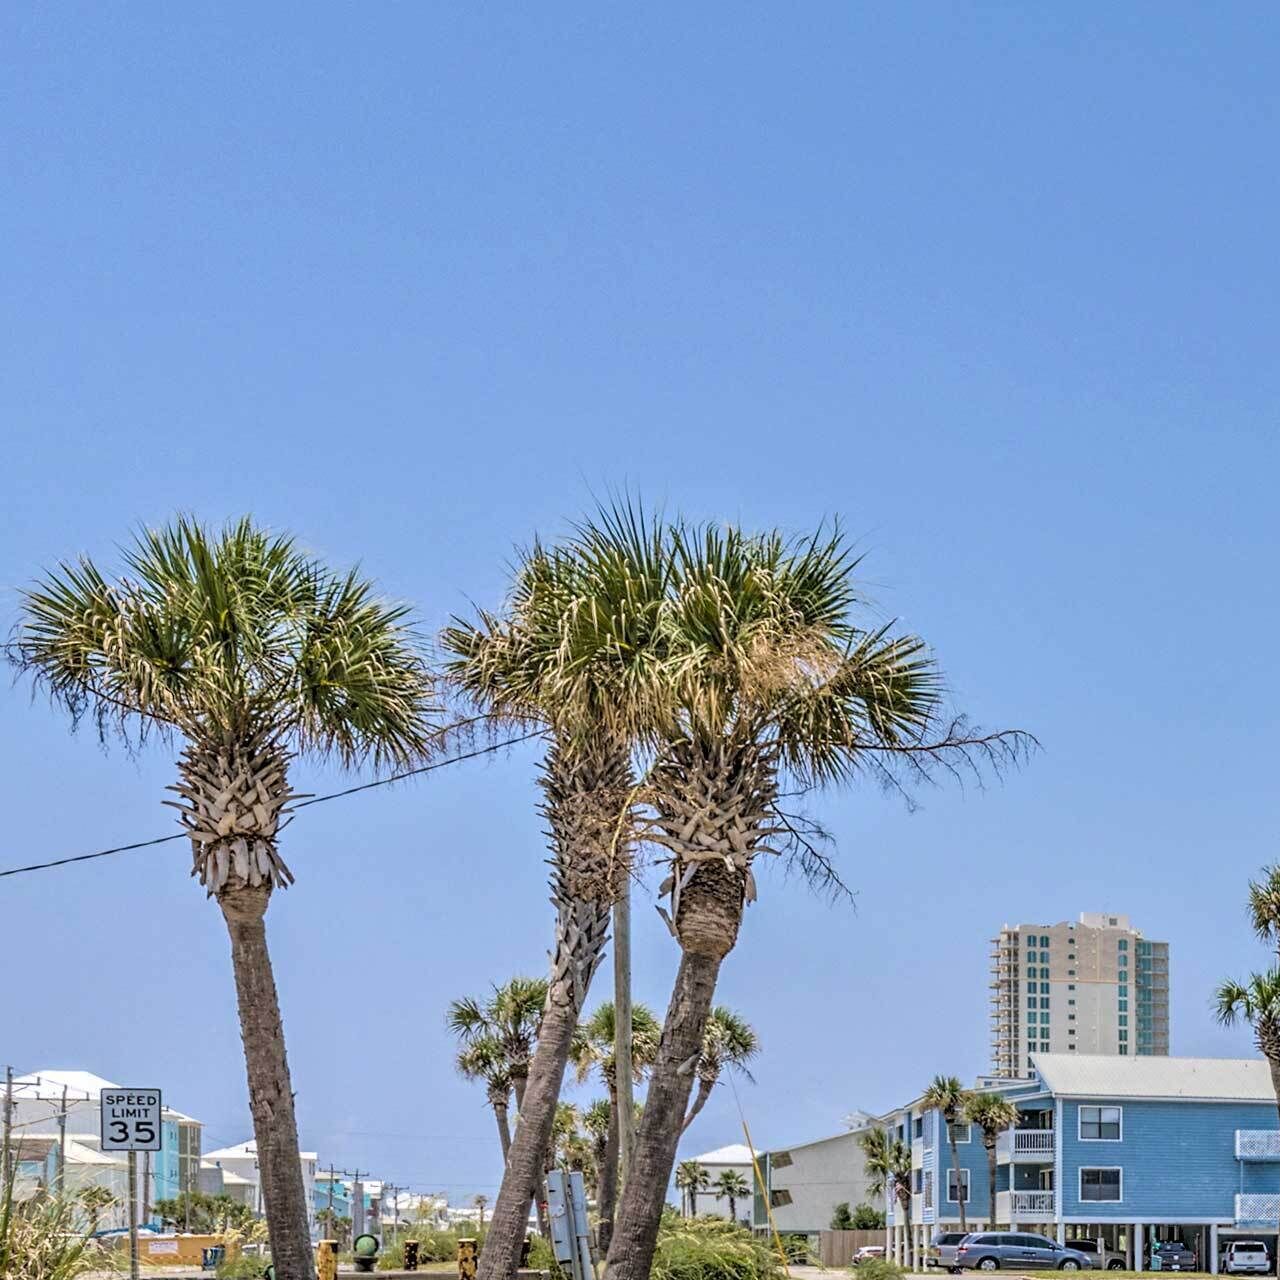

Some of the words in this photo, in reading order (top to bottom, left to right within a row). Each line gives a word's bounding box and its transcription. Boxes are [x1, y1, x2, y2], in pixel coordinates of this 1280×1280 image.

[106, 1095, 157, 1106] SPEED
[112, 1108, 150, 1118] LIMIT
[109, 1121, 155, 1143] 35
